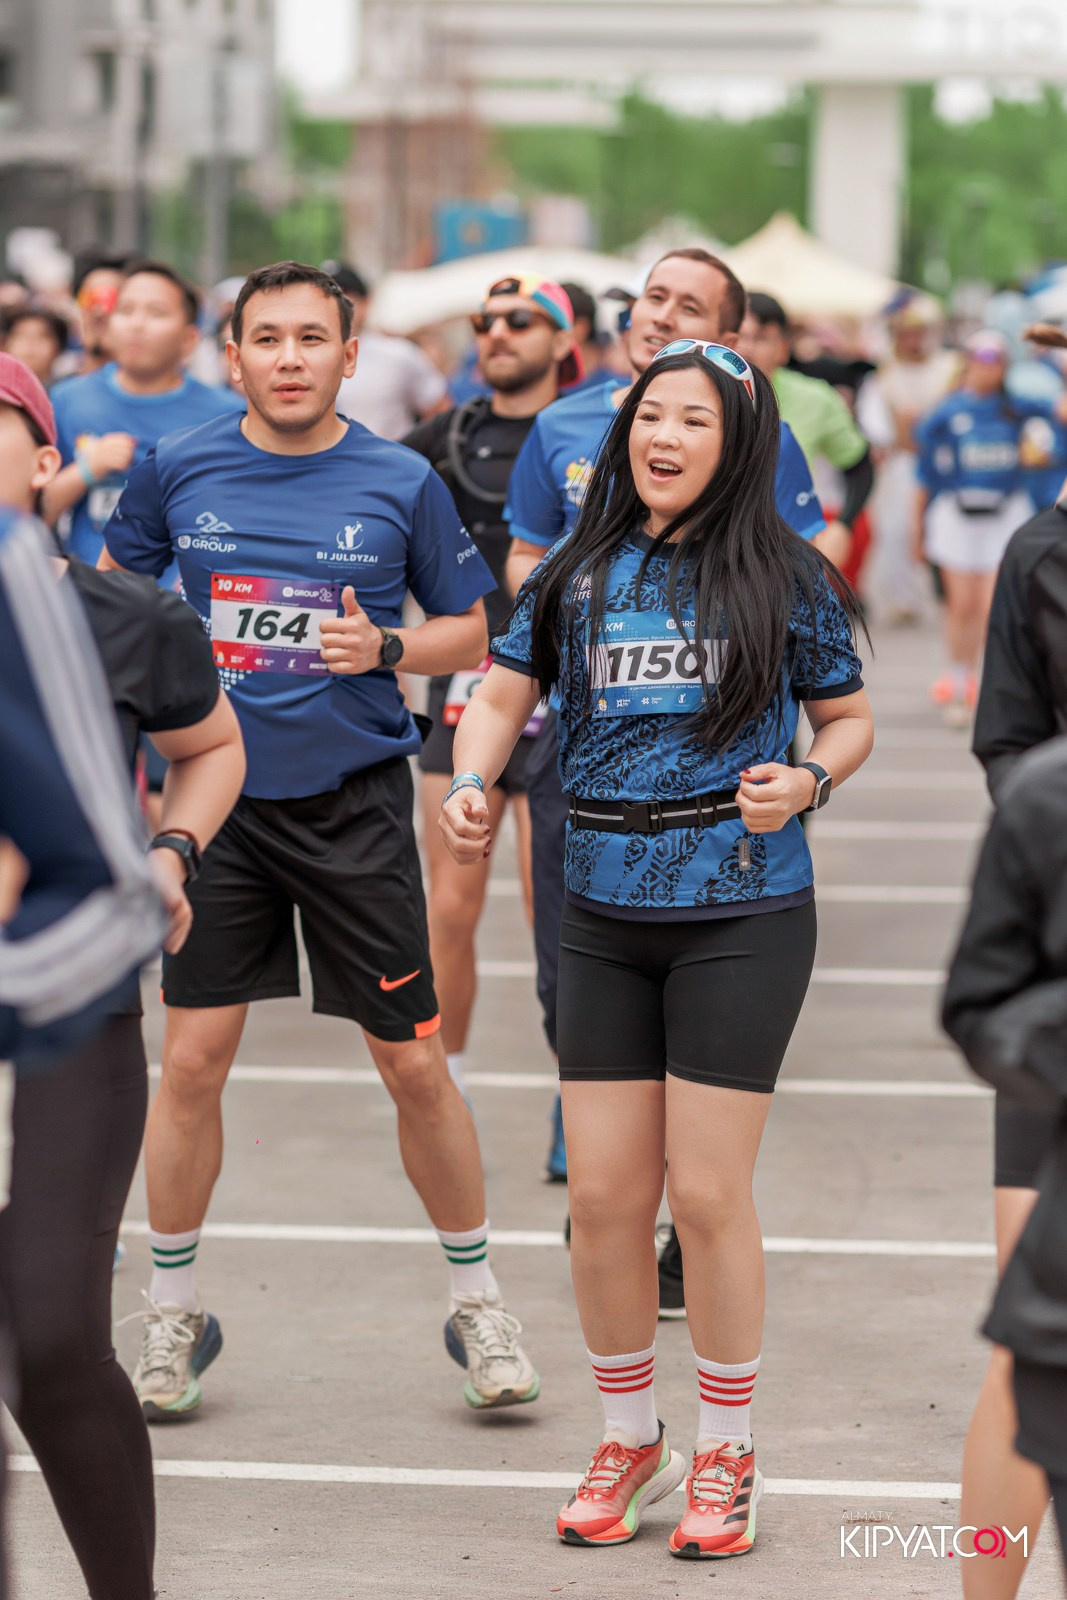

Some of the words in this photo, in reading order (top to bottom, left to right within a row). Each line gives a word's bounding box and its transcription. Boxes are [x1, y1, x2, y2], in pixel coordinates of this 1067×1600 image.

[192, 538, 237, 553] GROUP
[316, 551, 328, 560] BI
[329, 552, 379, 564] JULDYZAI
[218, 579, 233, 592] 10
[234, 583, 253, 594] KM
[294, 588, 319, 598] GROUP
[236, 608, 311, 644] 164
[605, 621, 625, 633] KM
[607, 643, 708, 683] 1150
